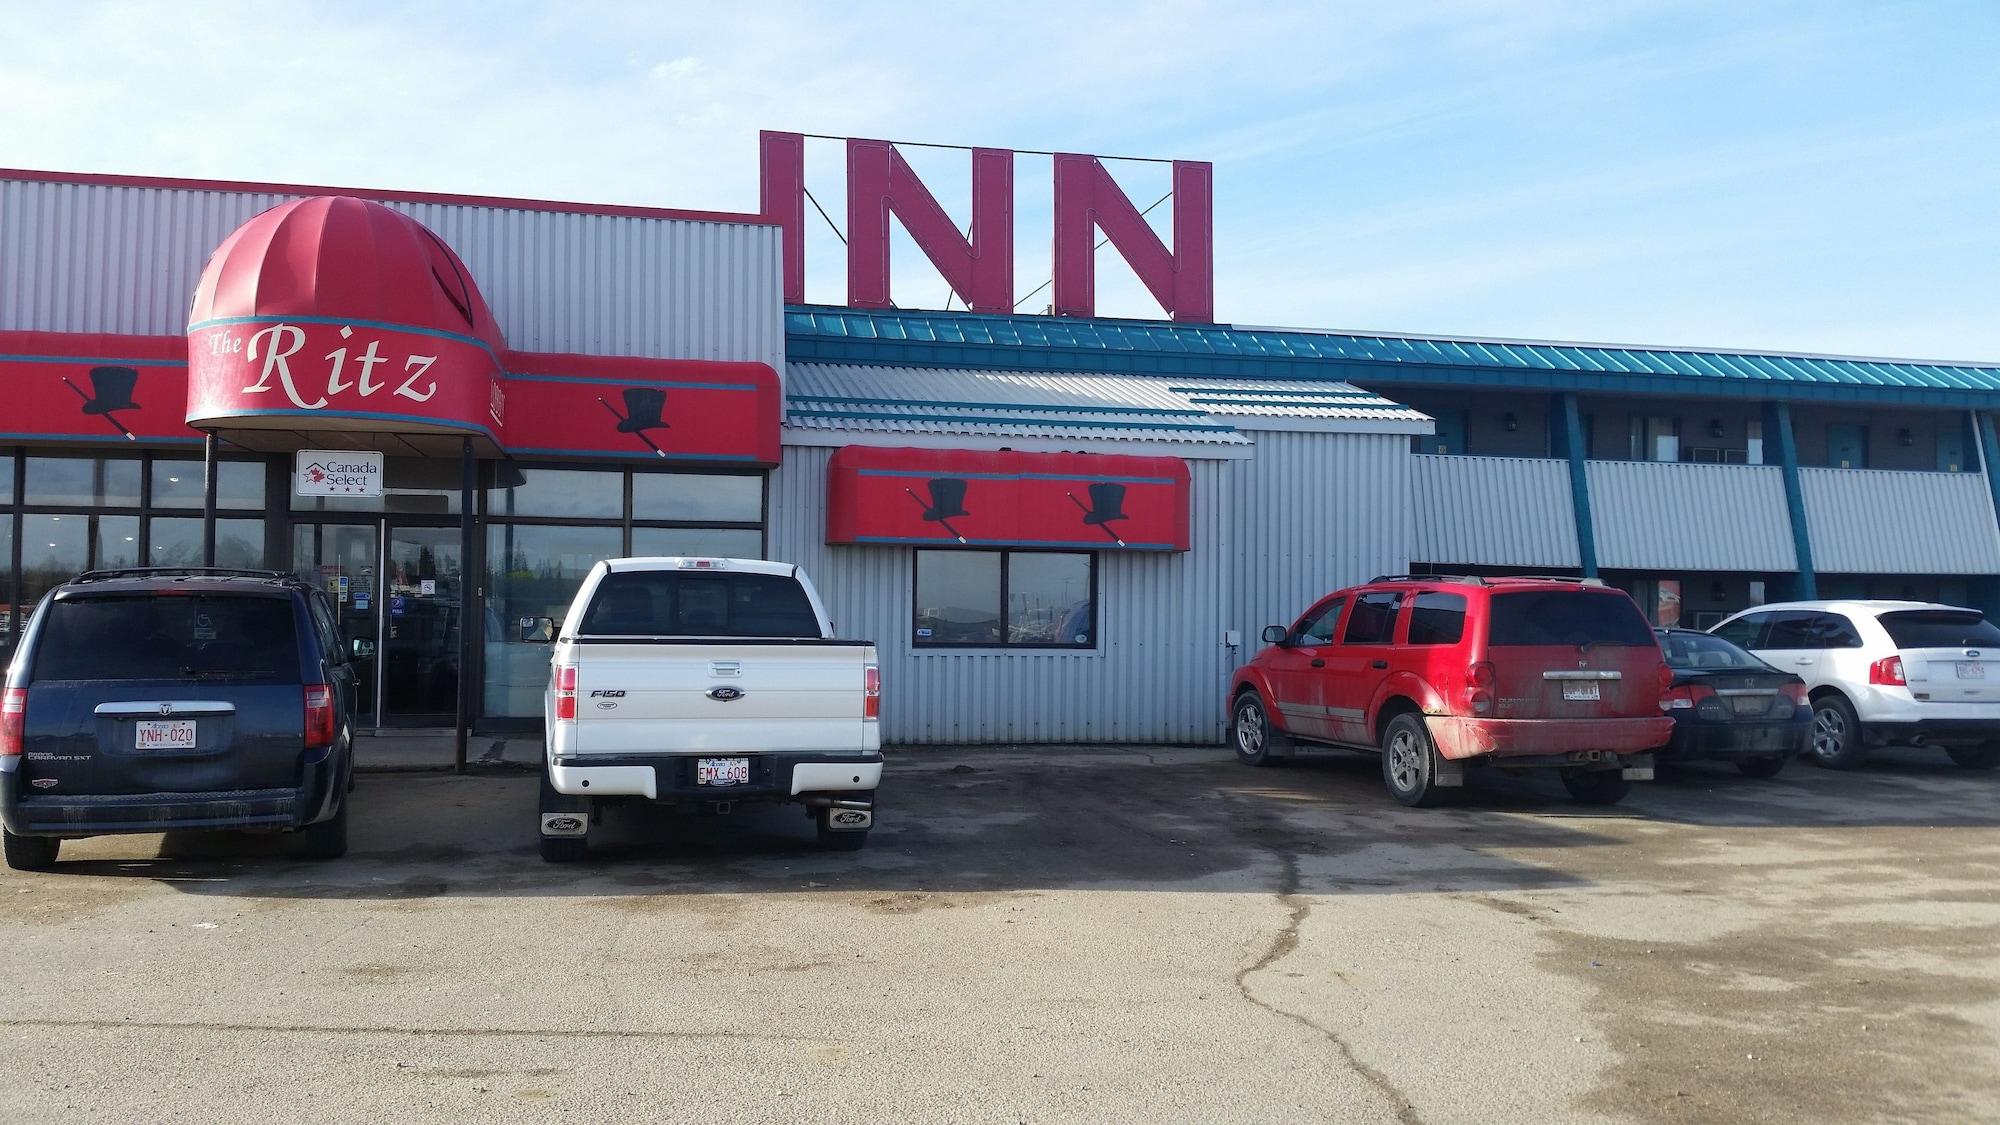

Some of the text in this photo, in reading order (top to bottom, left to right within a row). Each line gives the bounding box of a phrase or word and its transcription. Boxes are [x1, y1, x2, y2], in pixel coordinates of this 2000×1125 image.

[760, 130, 1213, 325] INN
[208, 322, 438, 410] The Ritz
[326, 461, 377, 474] Canada
[326, 473, 368, 486] Select
[140, 728, 193, 742] YNH-020
[699, 766, 748, 780] EMX-608
[552, 819, 577, 829] Ford
[840, 813, 861, 823] Ford
